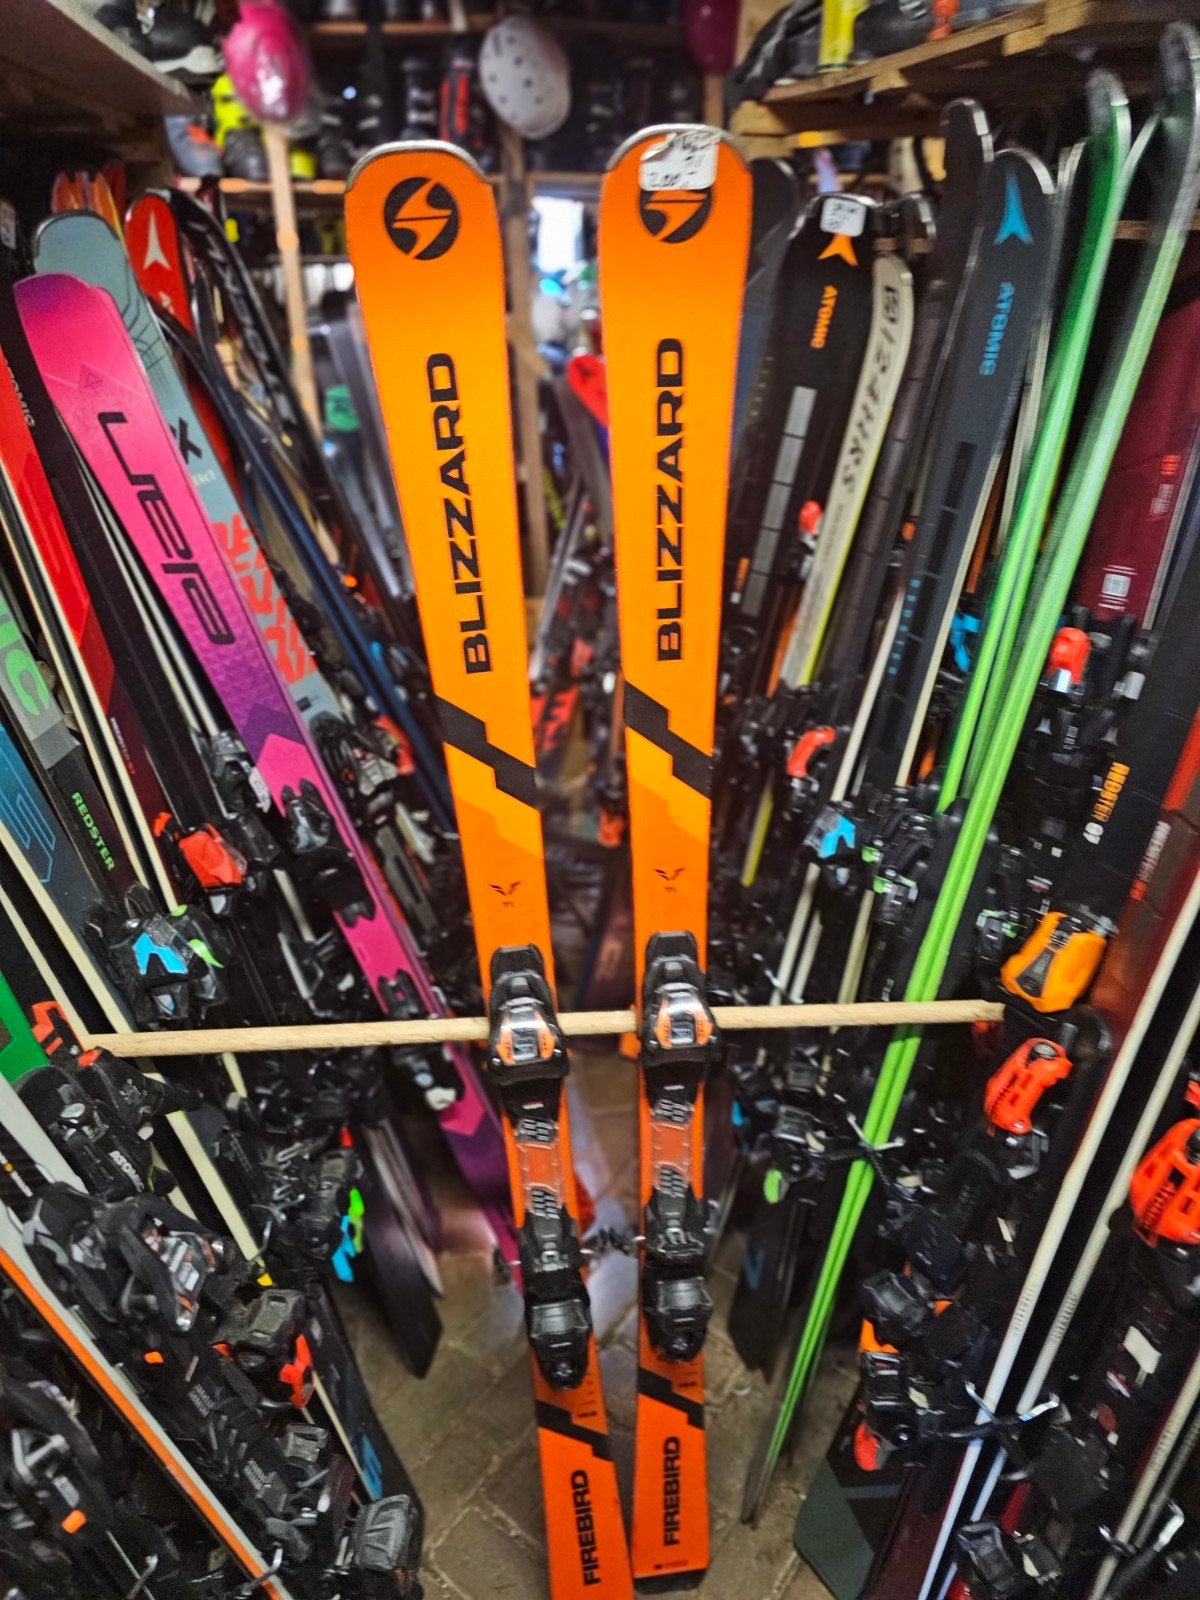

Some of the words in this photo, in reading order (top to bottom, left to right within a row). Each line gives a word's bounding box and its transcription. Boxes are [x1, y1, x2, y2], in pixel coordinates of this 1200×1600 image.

[810, 283, 839, 349] ATOMIC
[979, 281, 1016, 376] ATOMIC
[426, 352, 493, 675] BLIZZARD
[655, 337, 684, 662] BLIZZARD
[71, 791, 116, 872] REDSTER
[108, 1150, 145, 1193] ATOMIC
[571, 1469, 602, 1586] FIREBIRD
[663, 1436, 681, 1547] FIREBIRD
